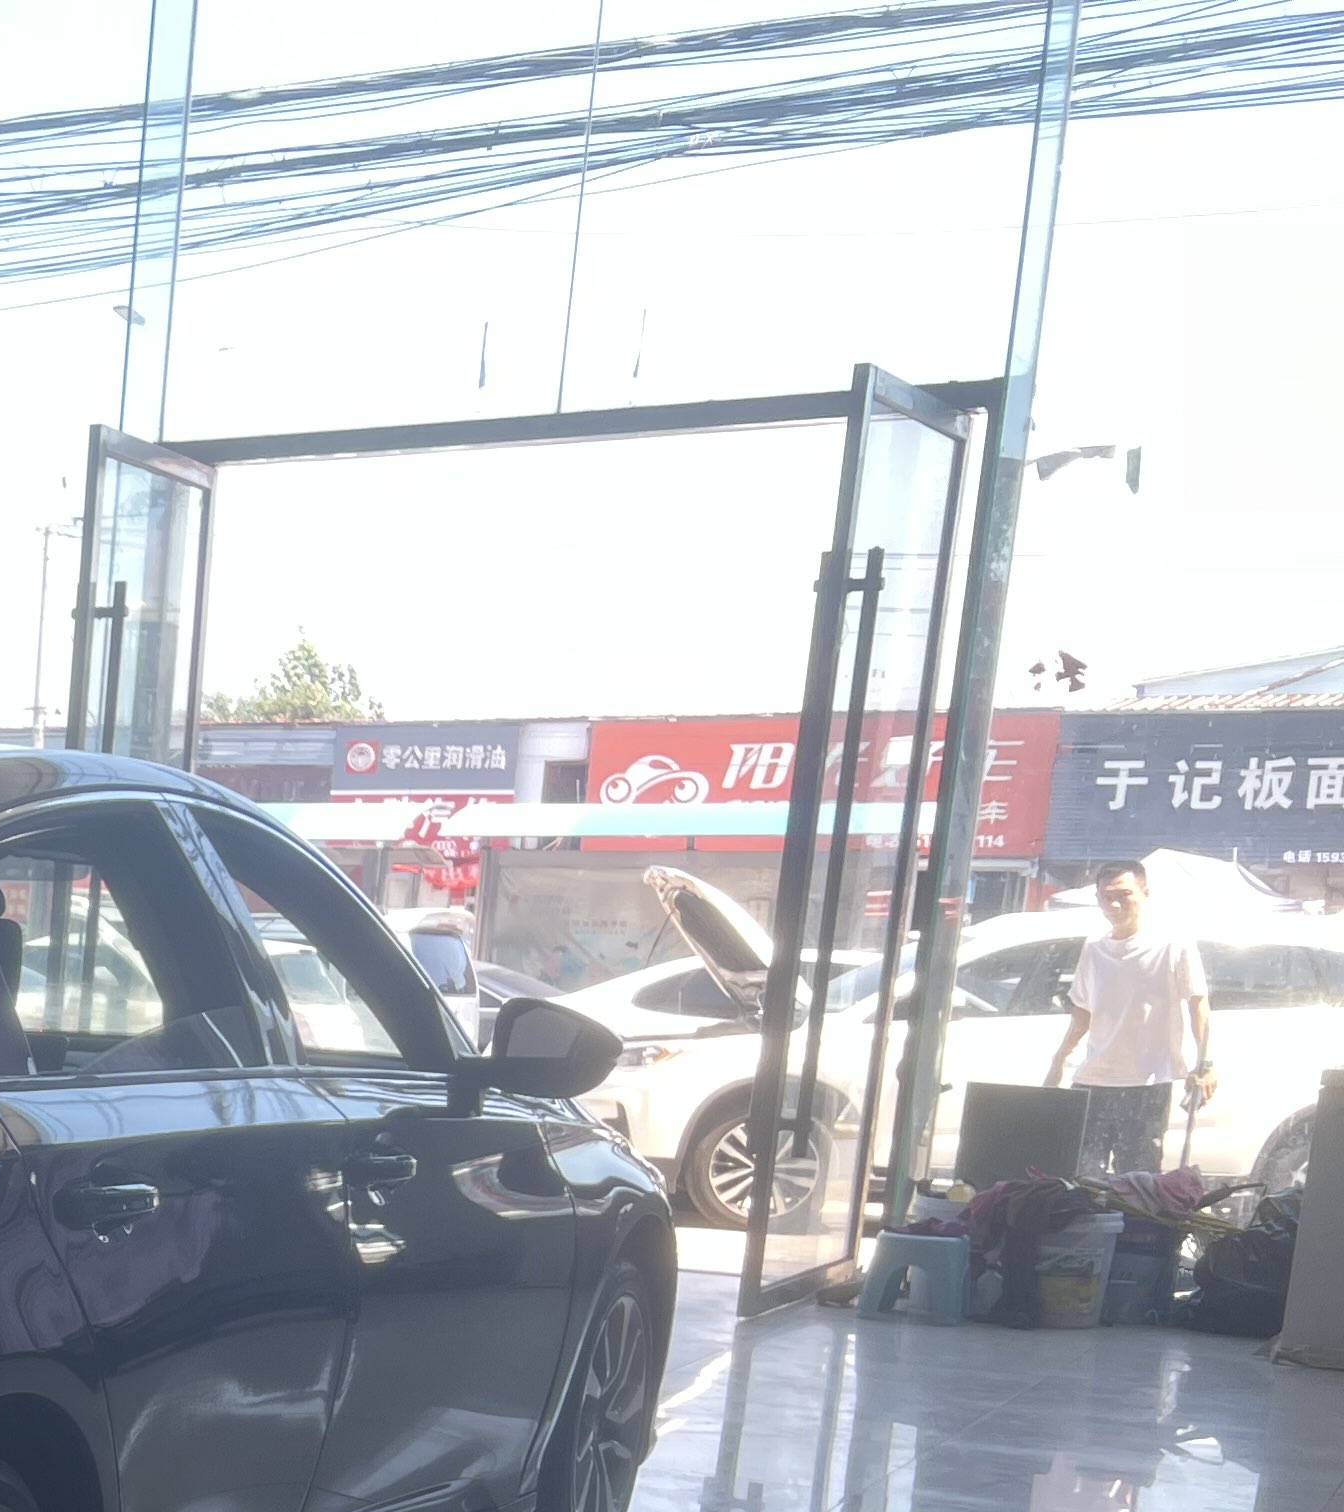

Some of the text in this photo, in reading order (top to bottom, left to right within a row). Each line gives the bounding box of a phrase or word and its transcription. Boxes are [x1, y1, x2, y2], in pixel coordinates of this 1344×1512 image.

[382, 744, 507, 770] 零公里润滑油
[1096, 757, 1344, 810] 于记板面
